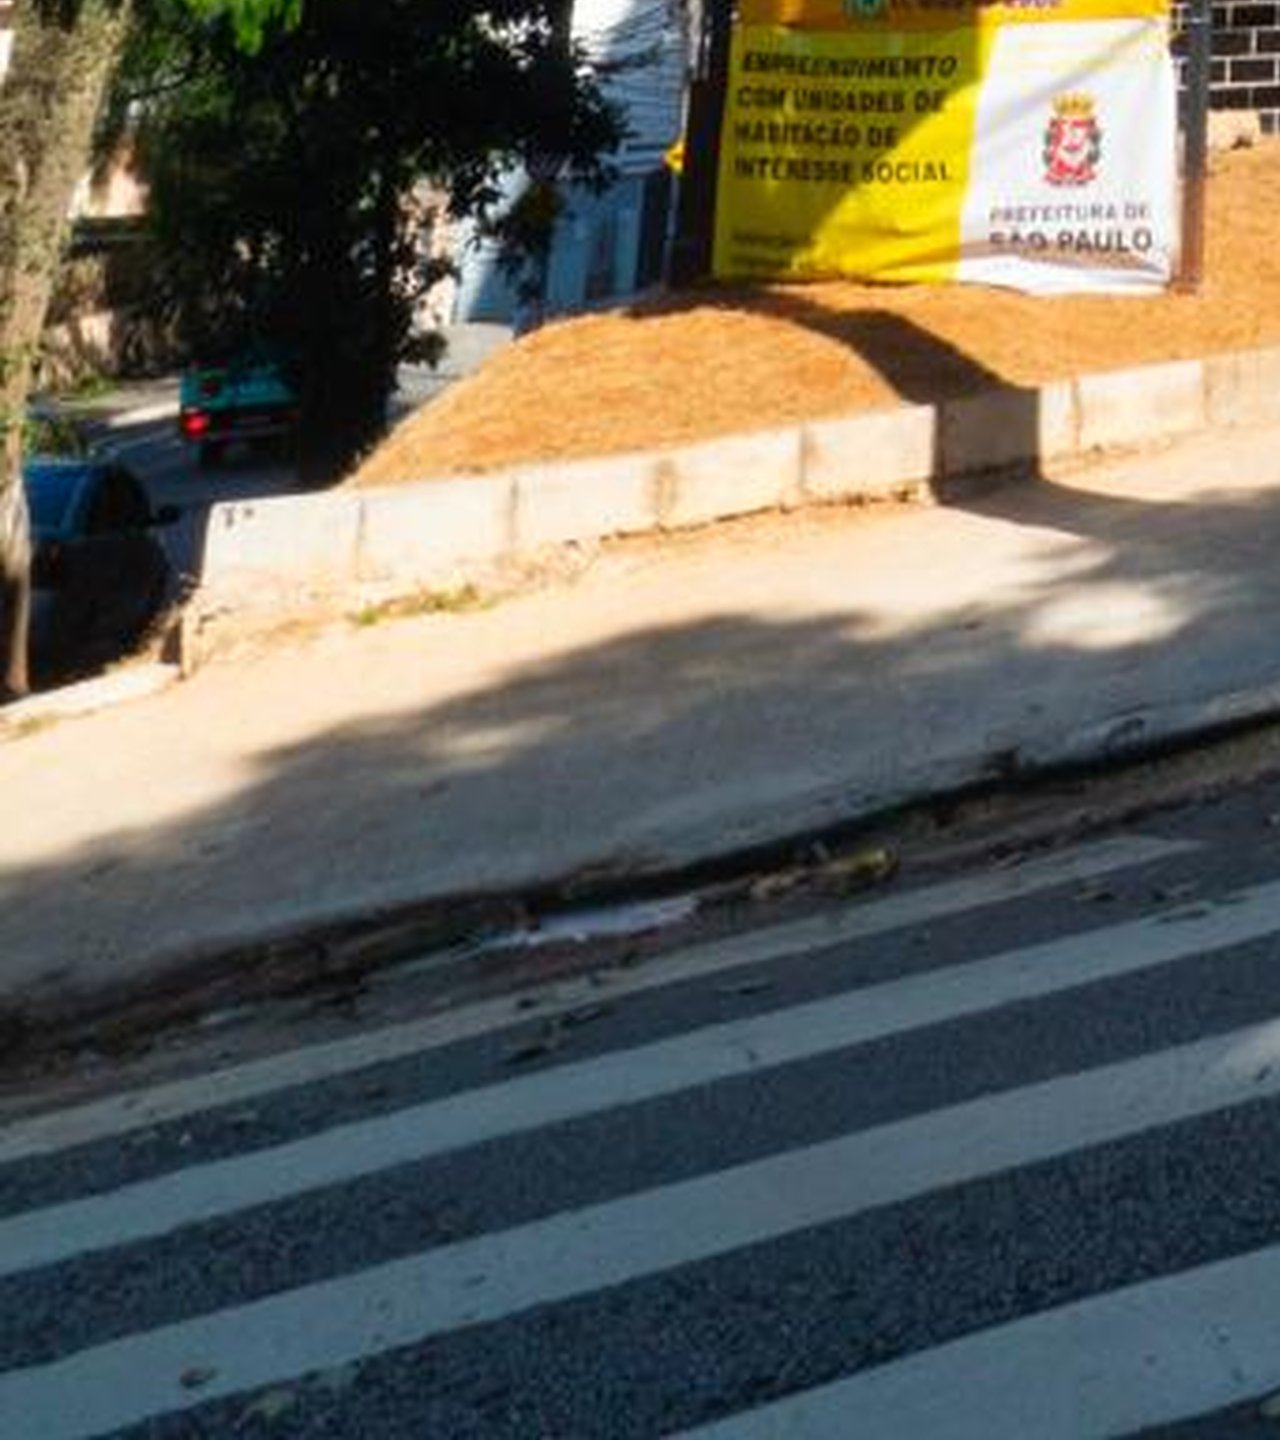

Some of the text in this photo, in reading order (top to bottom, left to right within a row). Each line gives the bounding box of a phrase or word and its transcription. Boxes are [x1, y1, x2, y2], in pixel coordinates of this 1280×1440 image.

[742, 51, 958, 78] EMPREENDIMENTO
[736, 86, 948, 114] COM UNIDADES DE
[733, 118, 900, 149] HABITAÇÃO DE
[733, 156, 953, 185] INTERESSE SOCIAL
[988, 202, 1149, 222] PREFEITURA DE
[1056, 227, 1153, 253] PAULO
